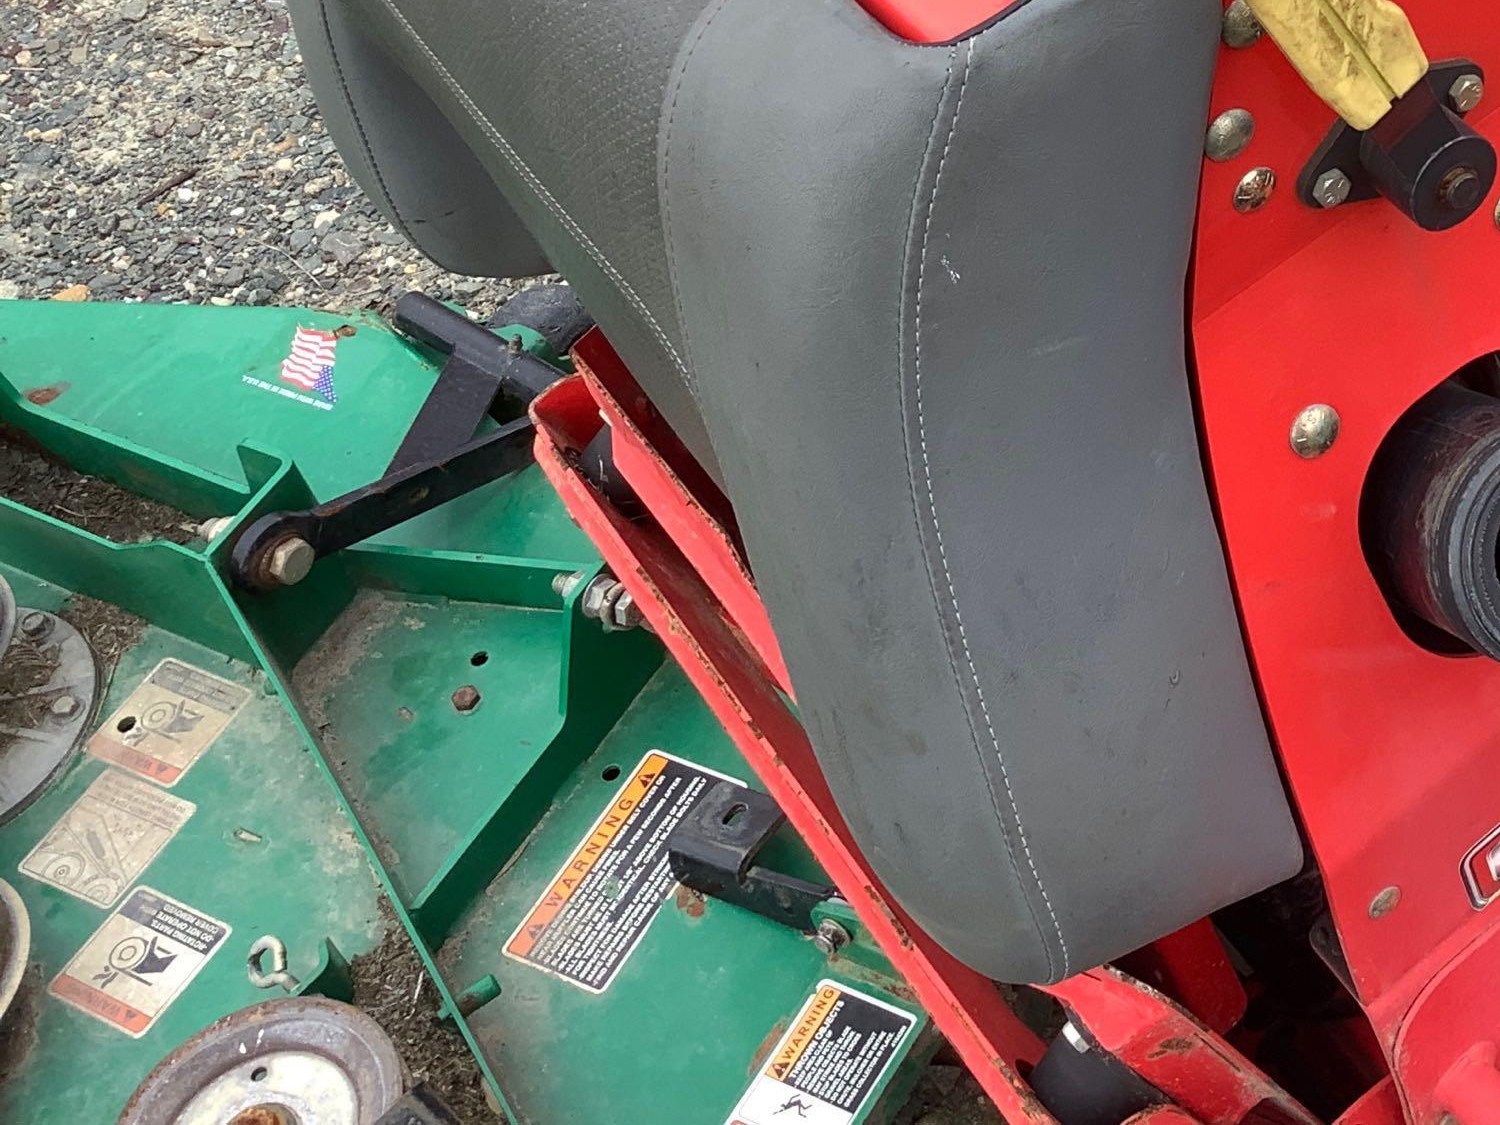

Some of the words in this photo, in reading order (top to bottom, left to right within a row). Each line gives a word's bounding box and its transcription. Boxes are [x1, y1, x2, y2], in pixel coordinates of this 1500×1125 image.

[545, 796, 635, 908] WARNING
[155, 910, 188, 930] OPERATE
[184, 925, 203, 937] NOT
[193, 918, 220, 935] COVER
[781, 987, 834, 1061] WARNING
[788, 1039, 819, 1079] THROWN
[814, 999, 845, 1040] OBJECTS
